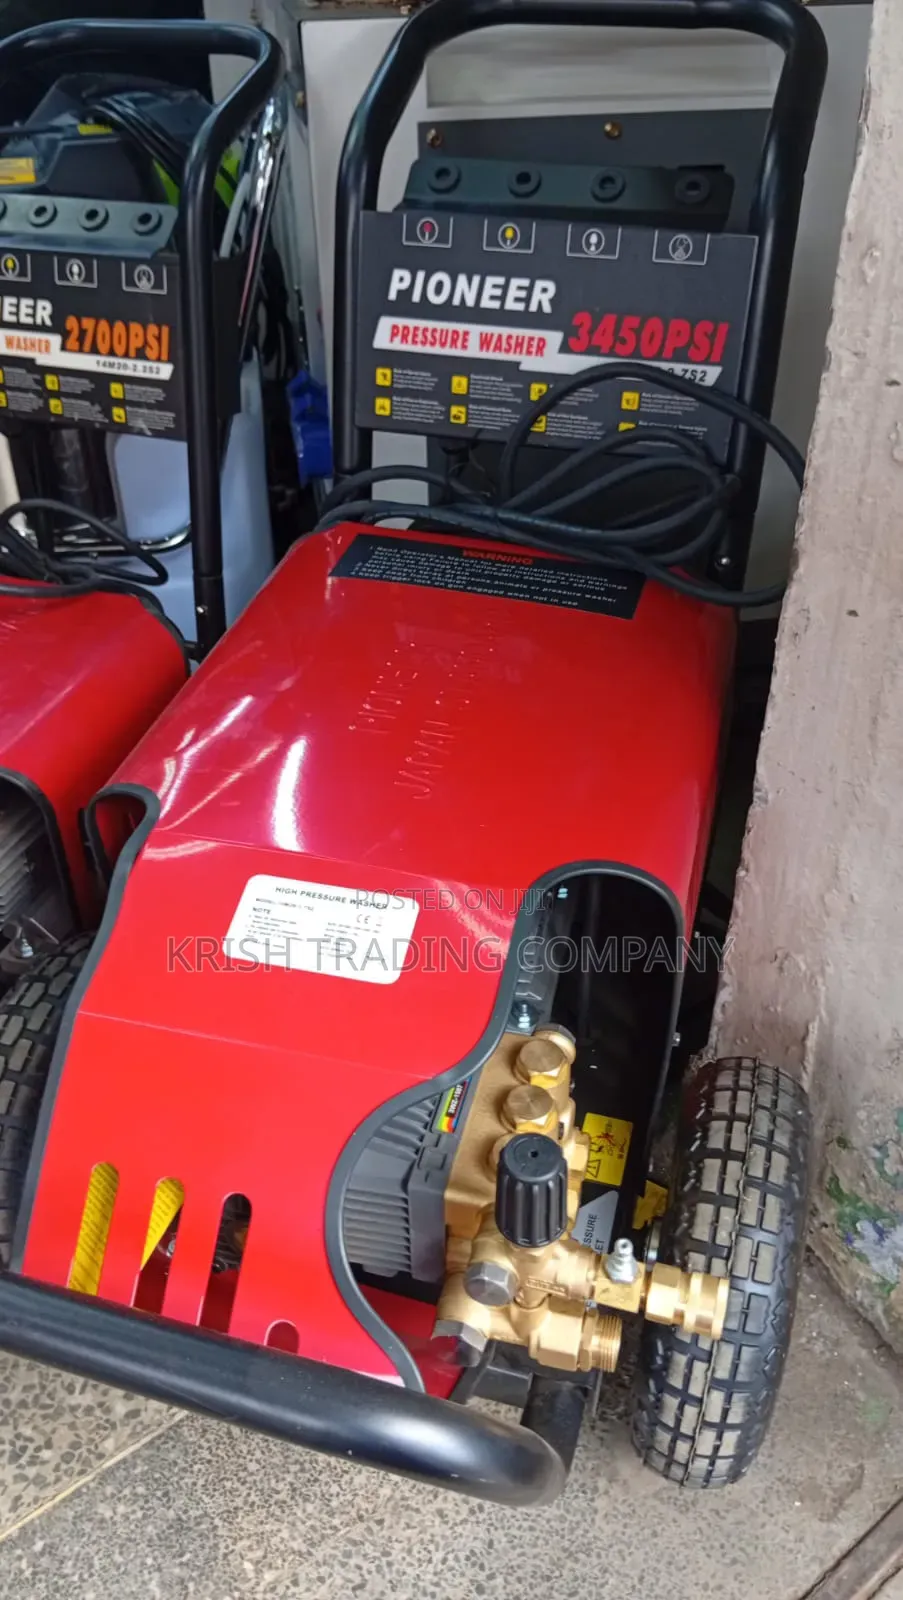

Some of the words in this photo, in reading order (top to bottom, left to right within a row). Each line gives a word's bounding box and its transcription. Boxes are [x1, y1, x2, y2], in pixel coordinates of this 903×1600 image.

[387, 268, 557, 314] PIONEER
[0, 295, 53, 327] EER
[4, 335, 51, 354] WASHER
[65, 315, 170, 362] 2700PSI
[388, 324, 470, 351] PRESSURE
[479, 331, 547, 357] WASHER
[567, 311, 731, 364] 3450PSI
[462, 549, 534, 566] WARNING
[275, 886, 298, 896] HIGH
[300, 890, 347, 903] PRESSURE
[350, 898, 388, 910] WASHER
[583, 1214, 598, 1248] SSURE
